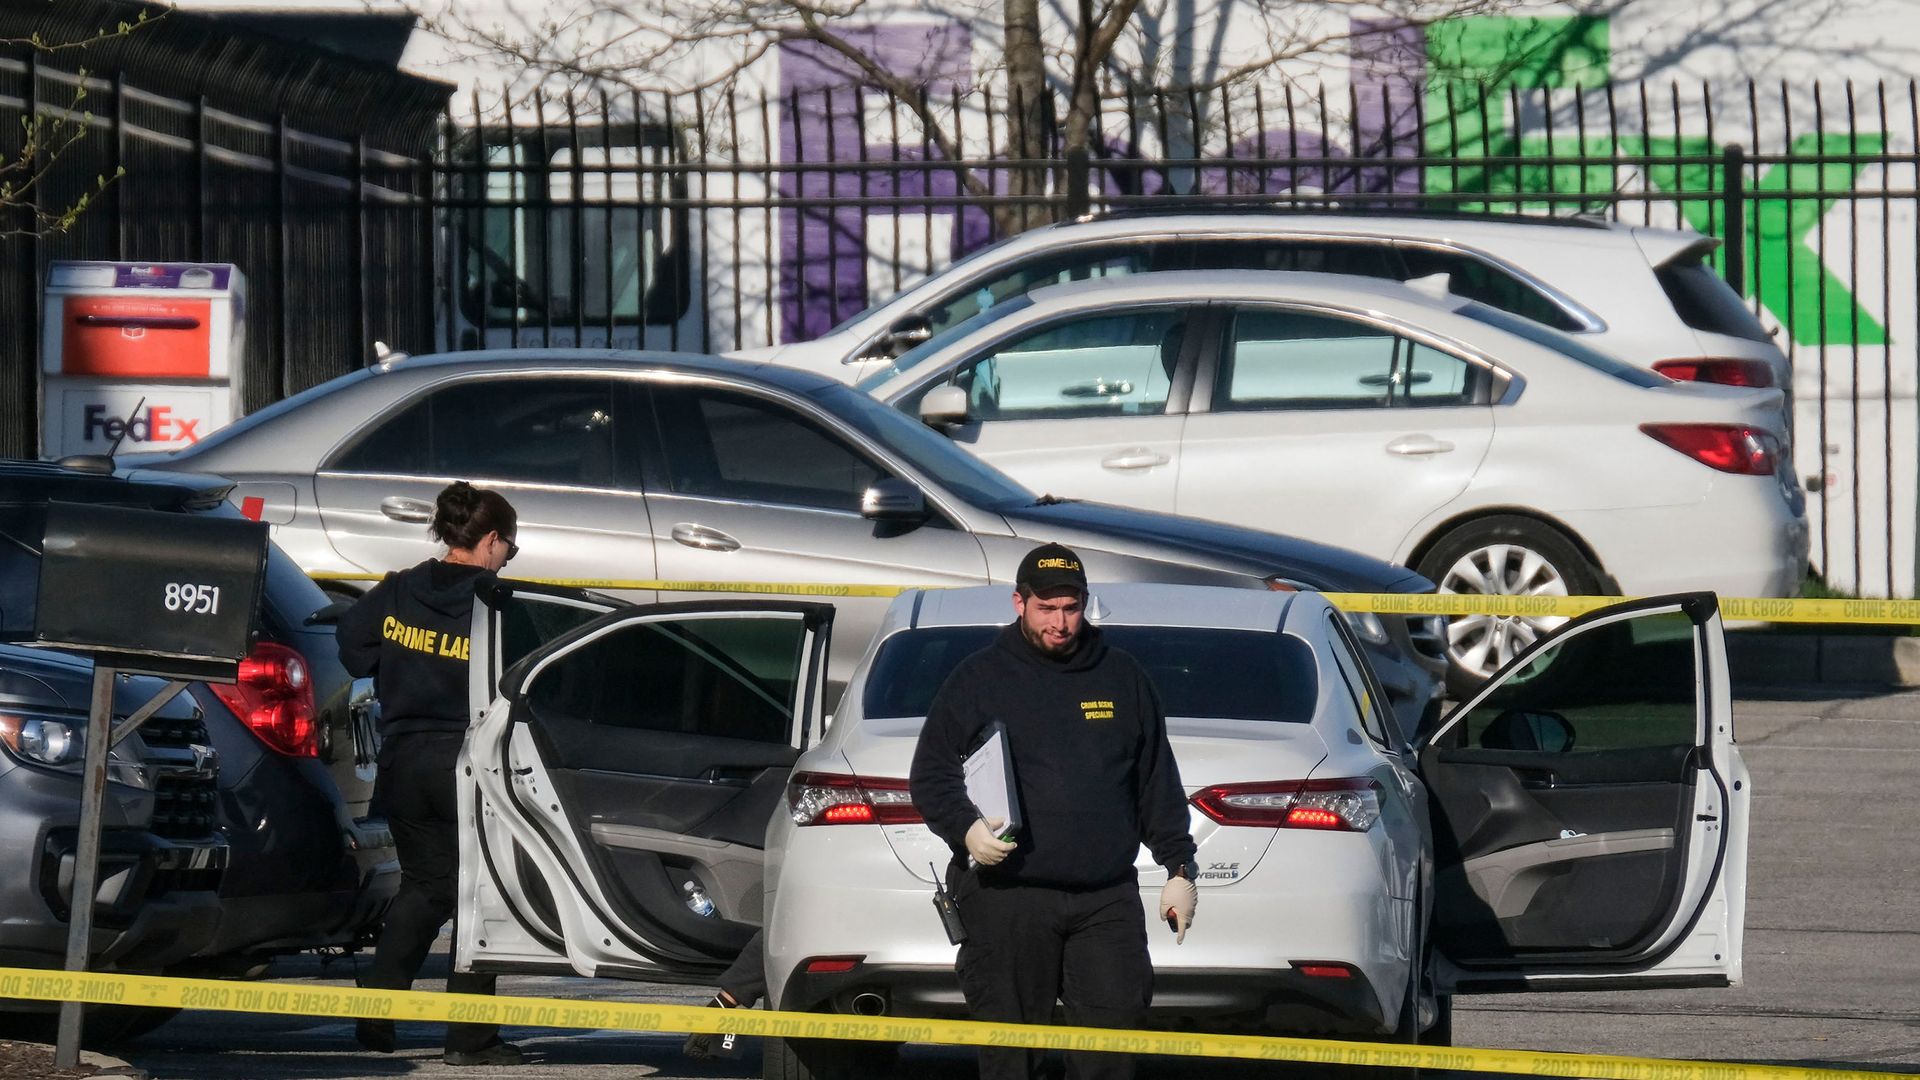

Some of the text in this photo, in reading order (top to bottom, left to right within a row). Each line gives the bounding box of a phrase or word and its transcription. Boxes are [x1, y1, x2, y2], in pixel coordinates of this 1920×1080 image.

[84, 404, 200, 444] FedEx
[1038, 558, 1065, 568] CRIME
[164, 582, 219, 614] 8951
[384, 616, 437, 653] CRIME
